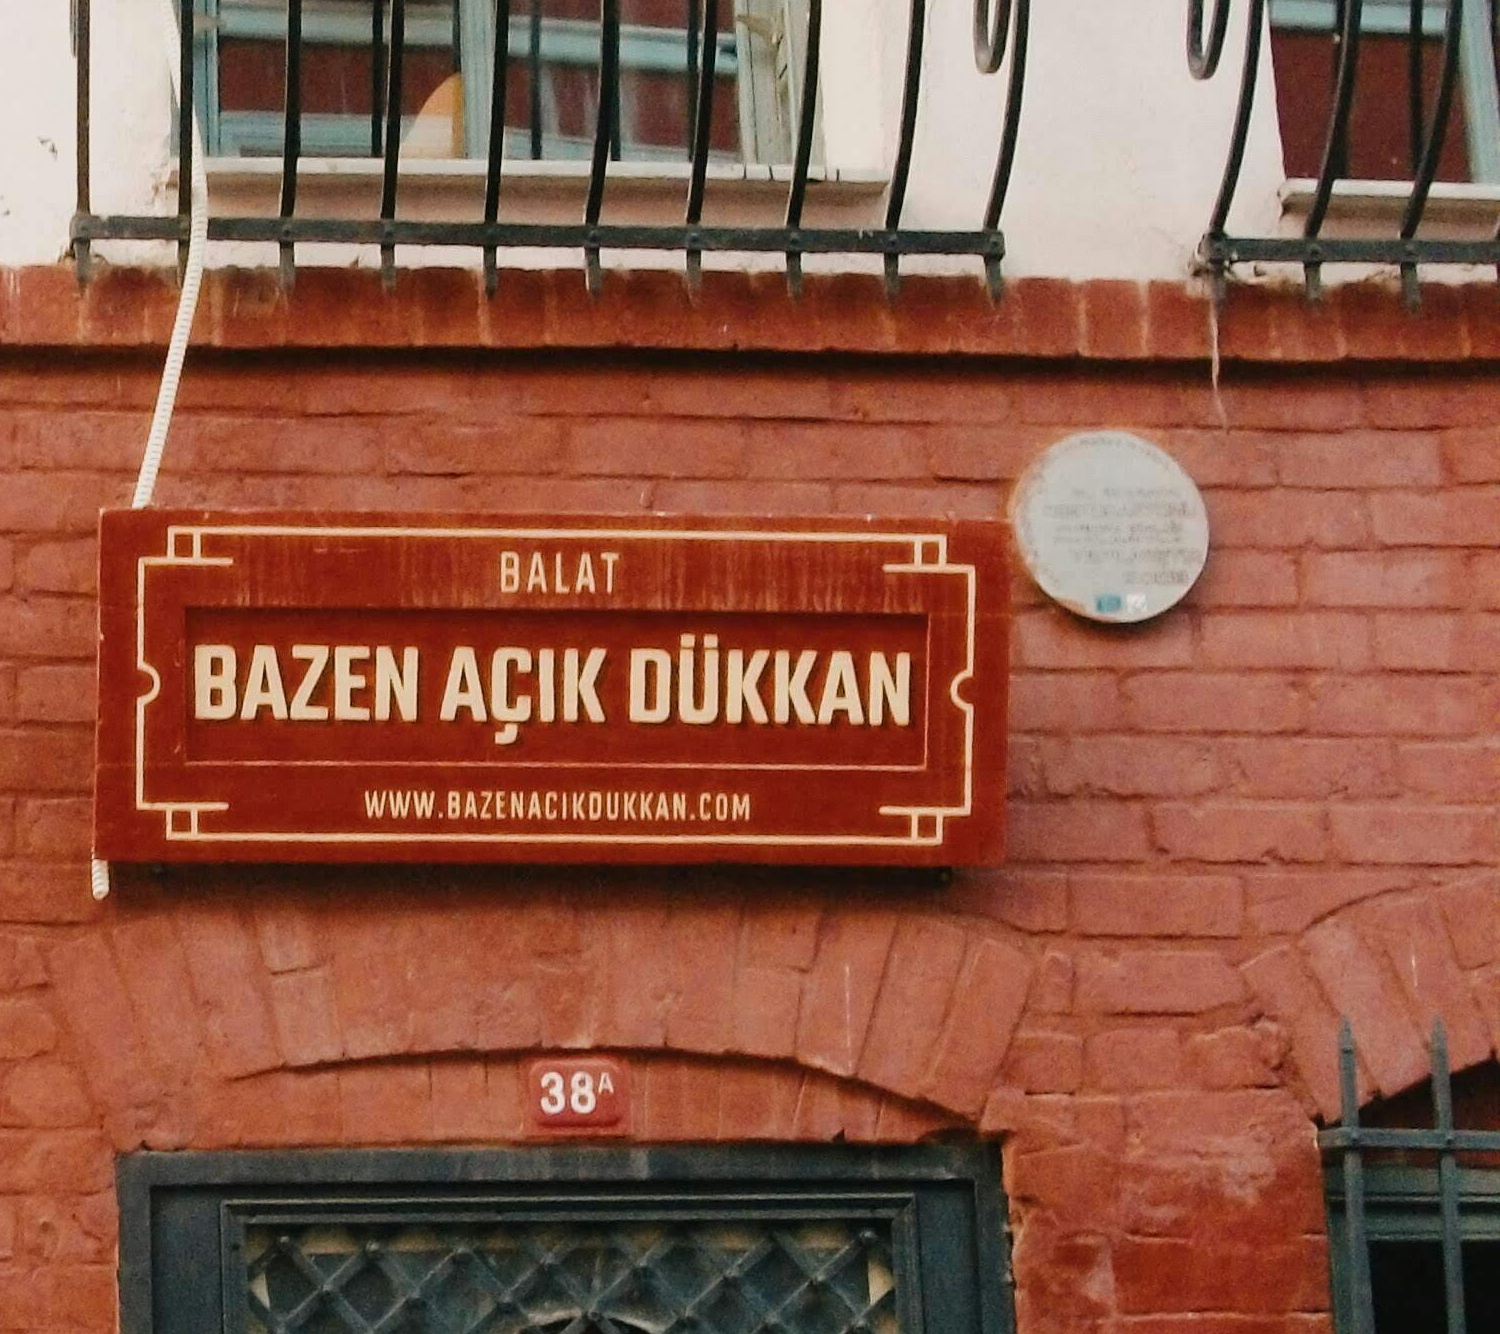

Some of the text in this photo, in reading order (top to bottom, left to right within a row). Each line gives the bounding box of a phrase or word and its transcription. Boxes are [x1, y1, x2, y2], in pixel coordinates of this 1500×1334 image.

[499, 550, 621, 595] BALAT
[193, 633, 912, 746] BAZEN AÇIK DÜKKAN
[363, 789, 751, 822] WWW.BAZENACIKDUKKAN.COM
